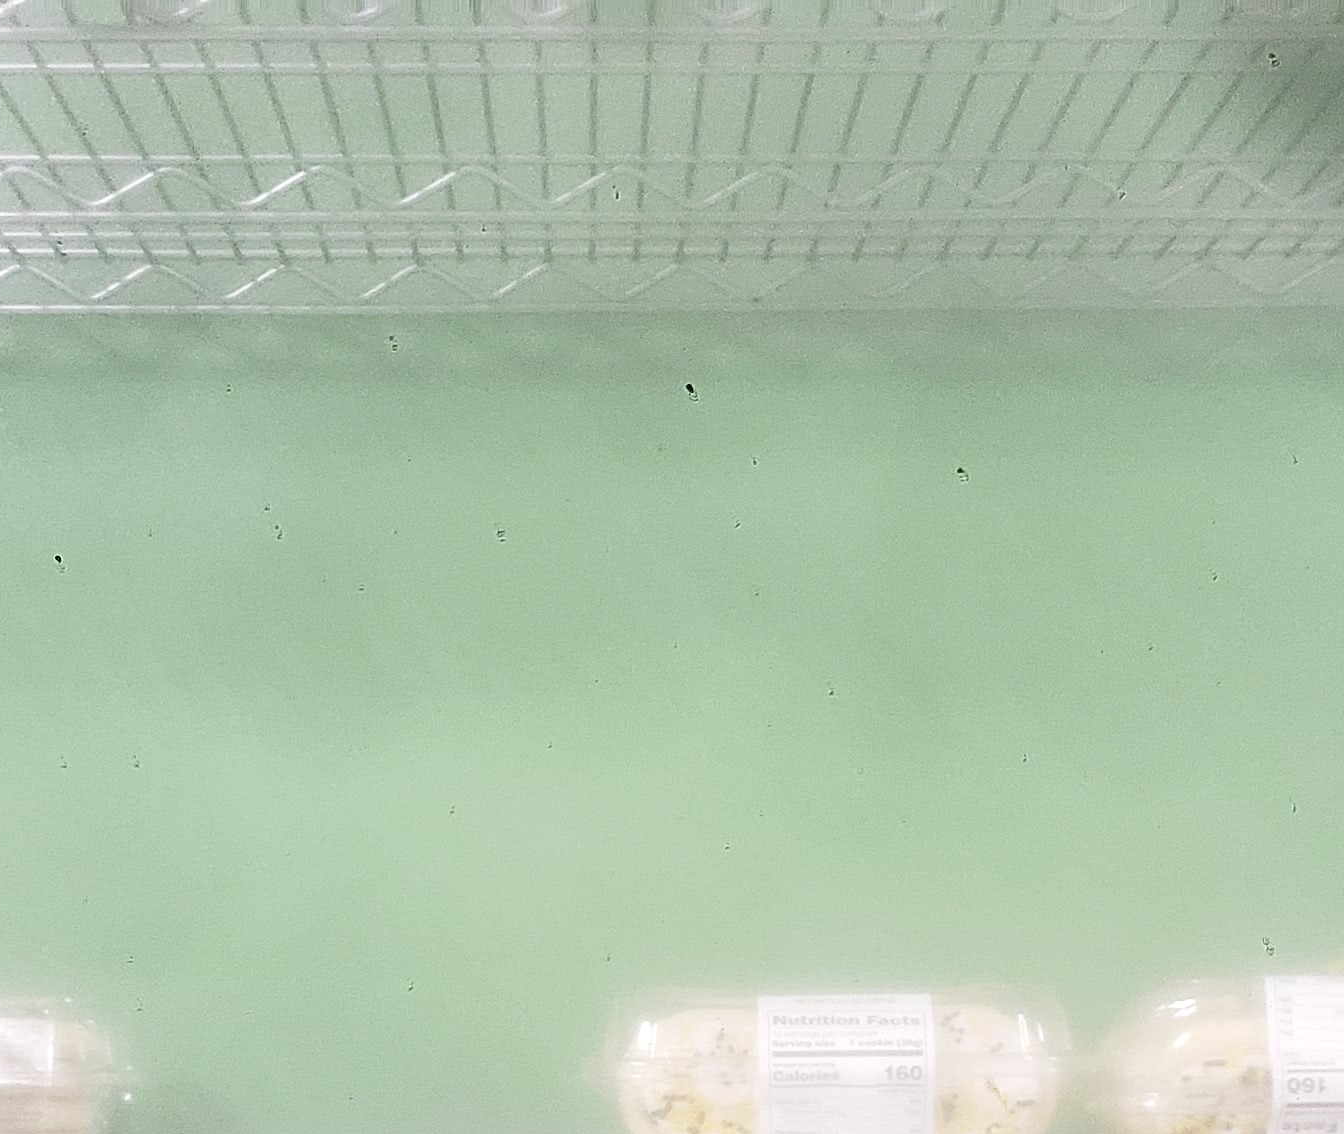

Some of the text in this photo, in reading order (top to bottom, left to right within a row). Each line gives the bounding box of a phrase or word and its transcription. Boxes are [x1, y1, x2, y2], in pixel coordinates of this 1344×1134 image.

[772, 1014, 921, 1027] Nutrition Facts
[772, 1039, 812, 1048] Serving
[772, 1065, 923, 1082] Calories 160
[1286, 1076, 1327, 1094] 160
[1281, 1119, 1339, 1134] Facts
